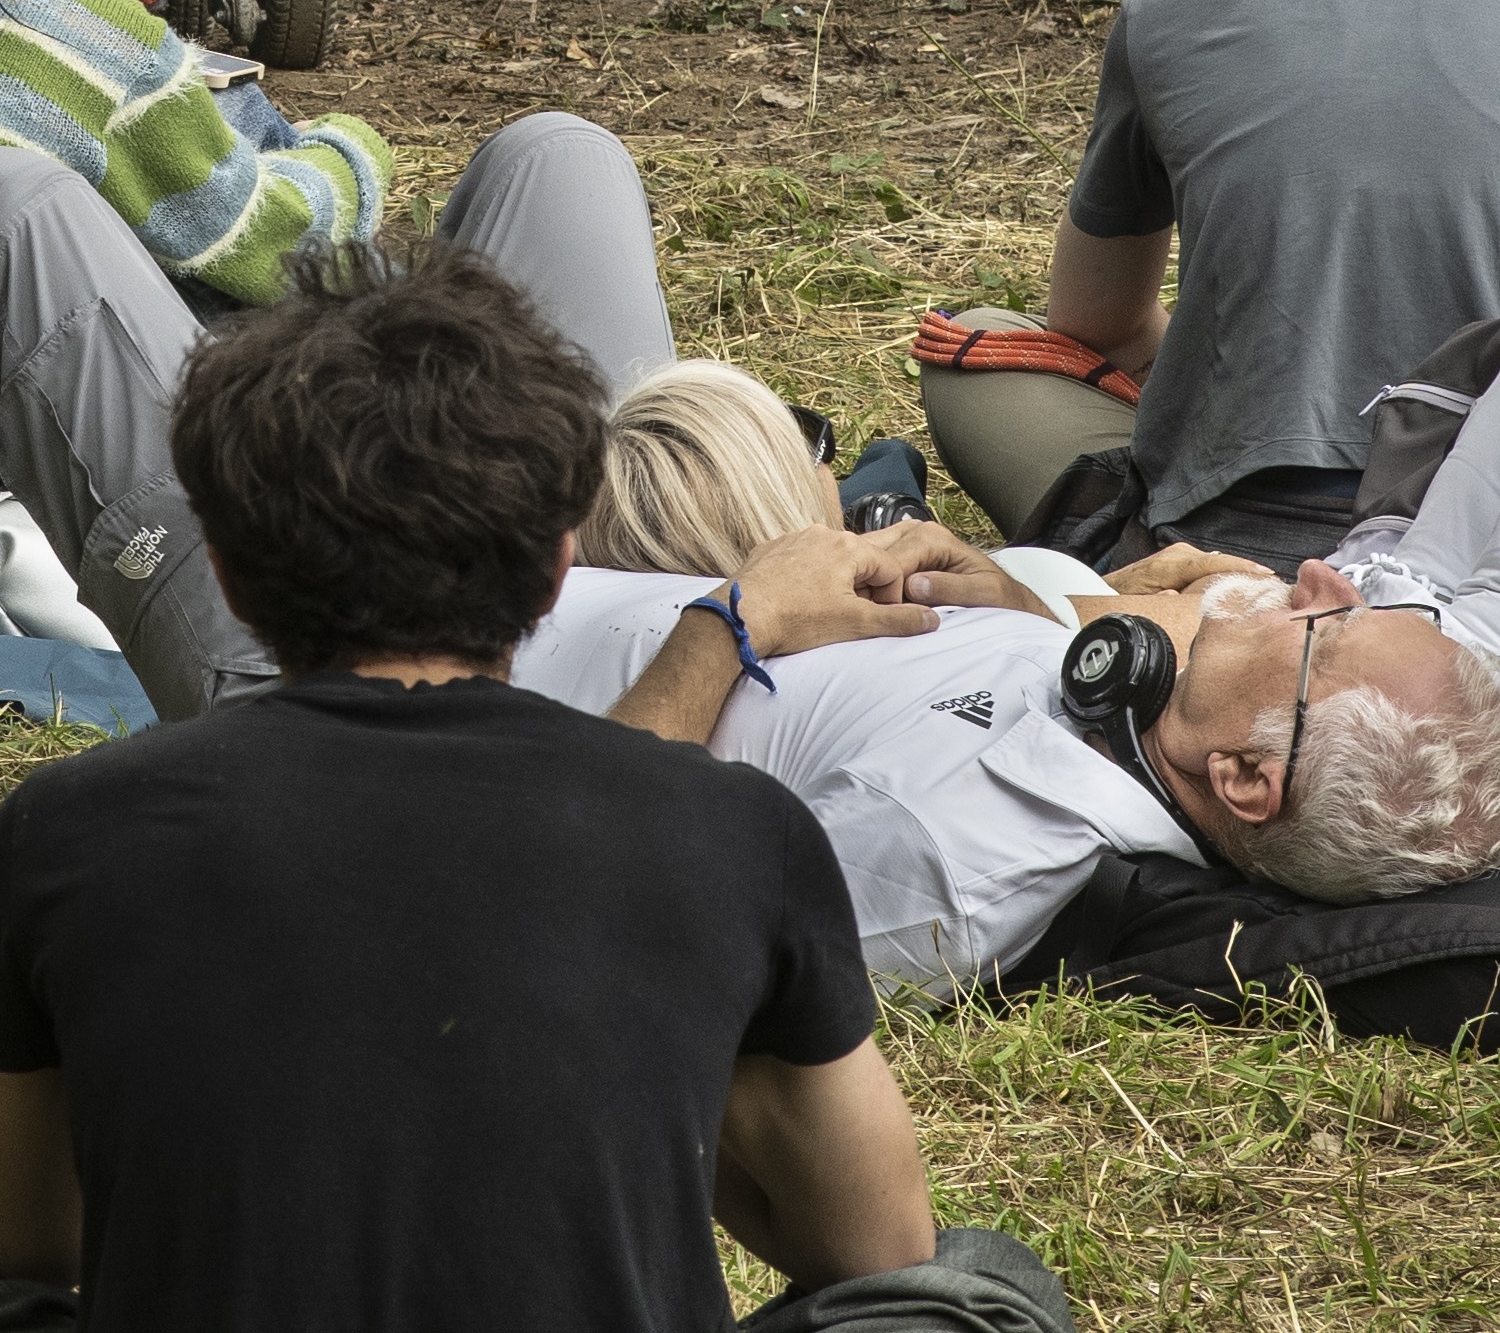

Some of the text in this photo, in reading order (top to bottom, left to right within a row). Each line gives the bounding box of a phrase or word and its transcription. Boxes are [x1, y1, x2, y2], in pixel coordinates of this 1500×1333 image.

[124, 526, 150, 560] FACE
[134, 524, 168, 565] NORTH
[144, 550, 165, 573] THE
[929, 690, 993, 712] adidas
